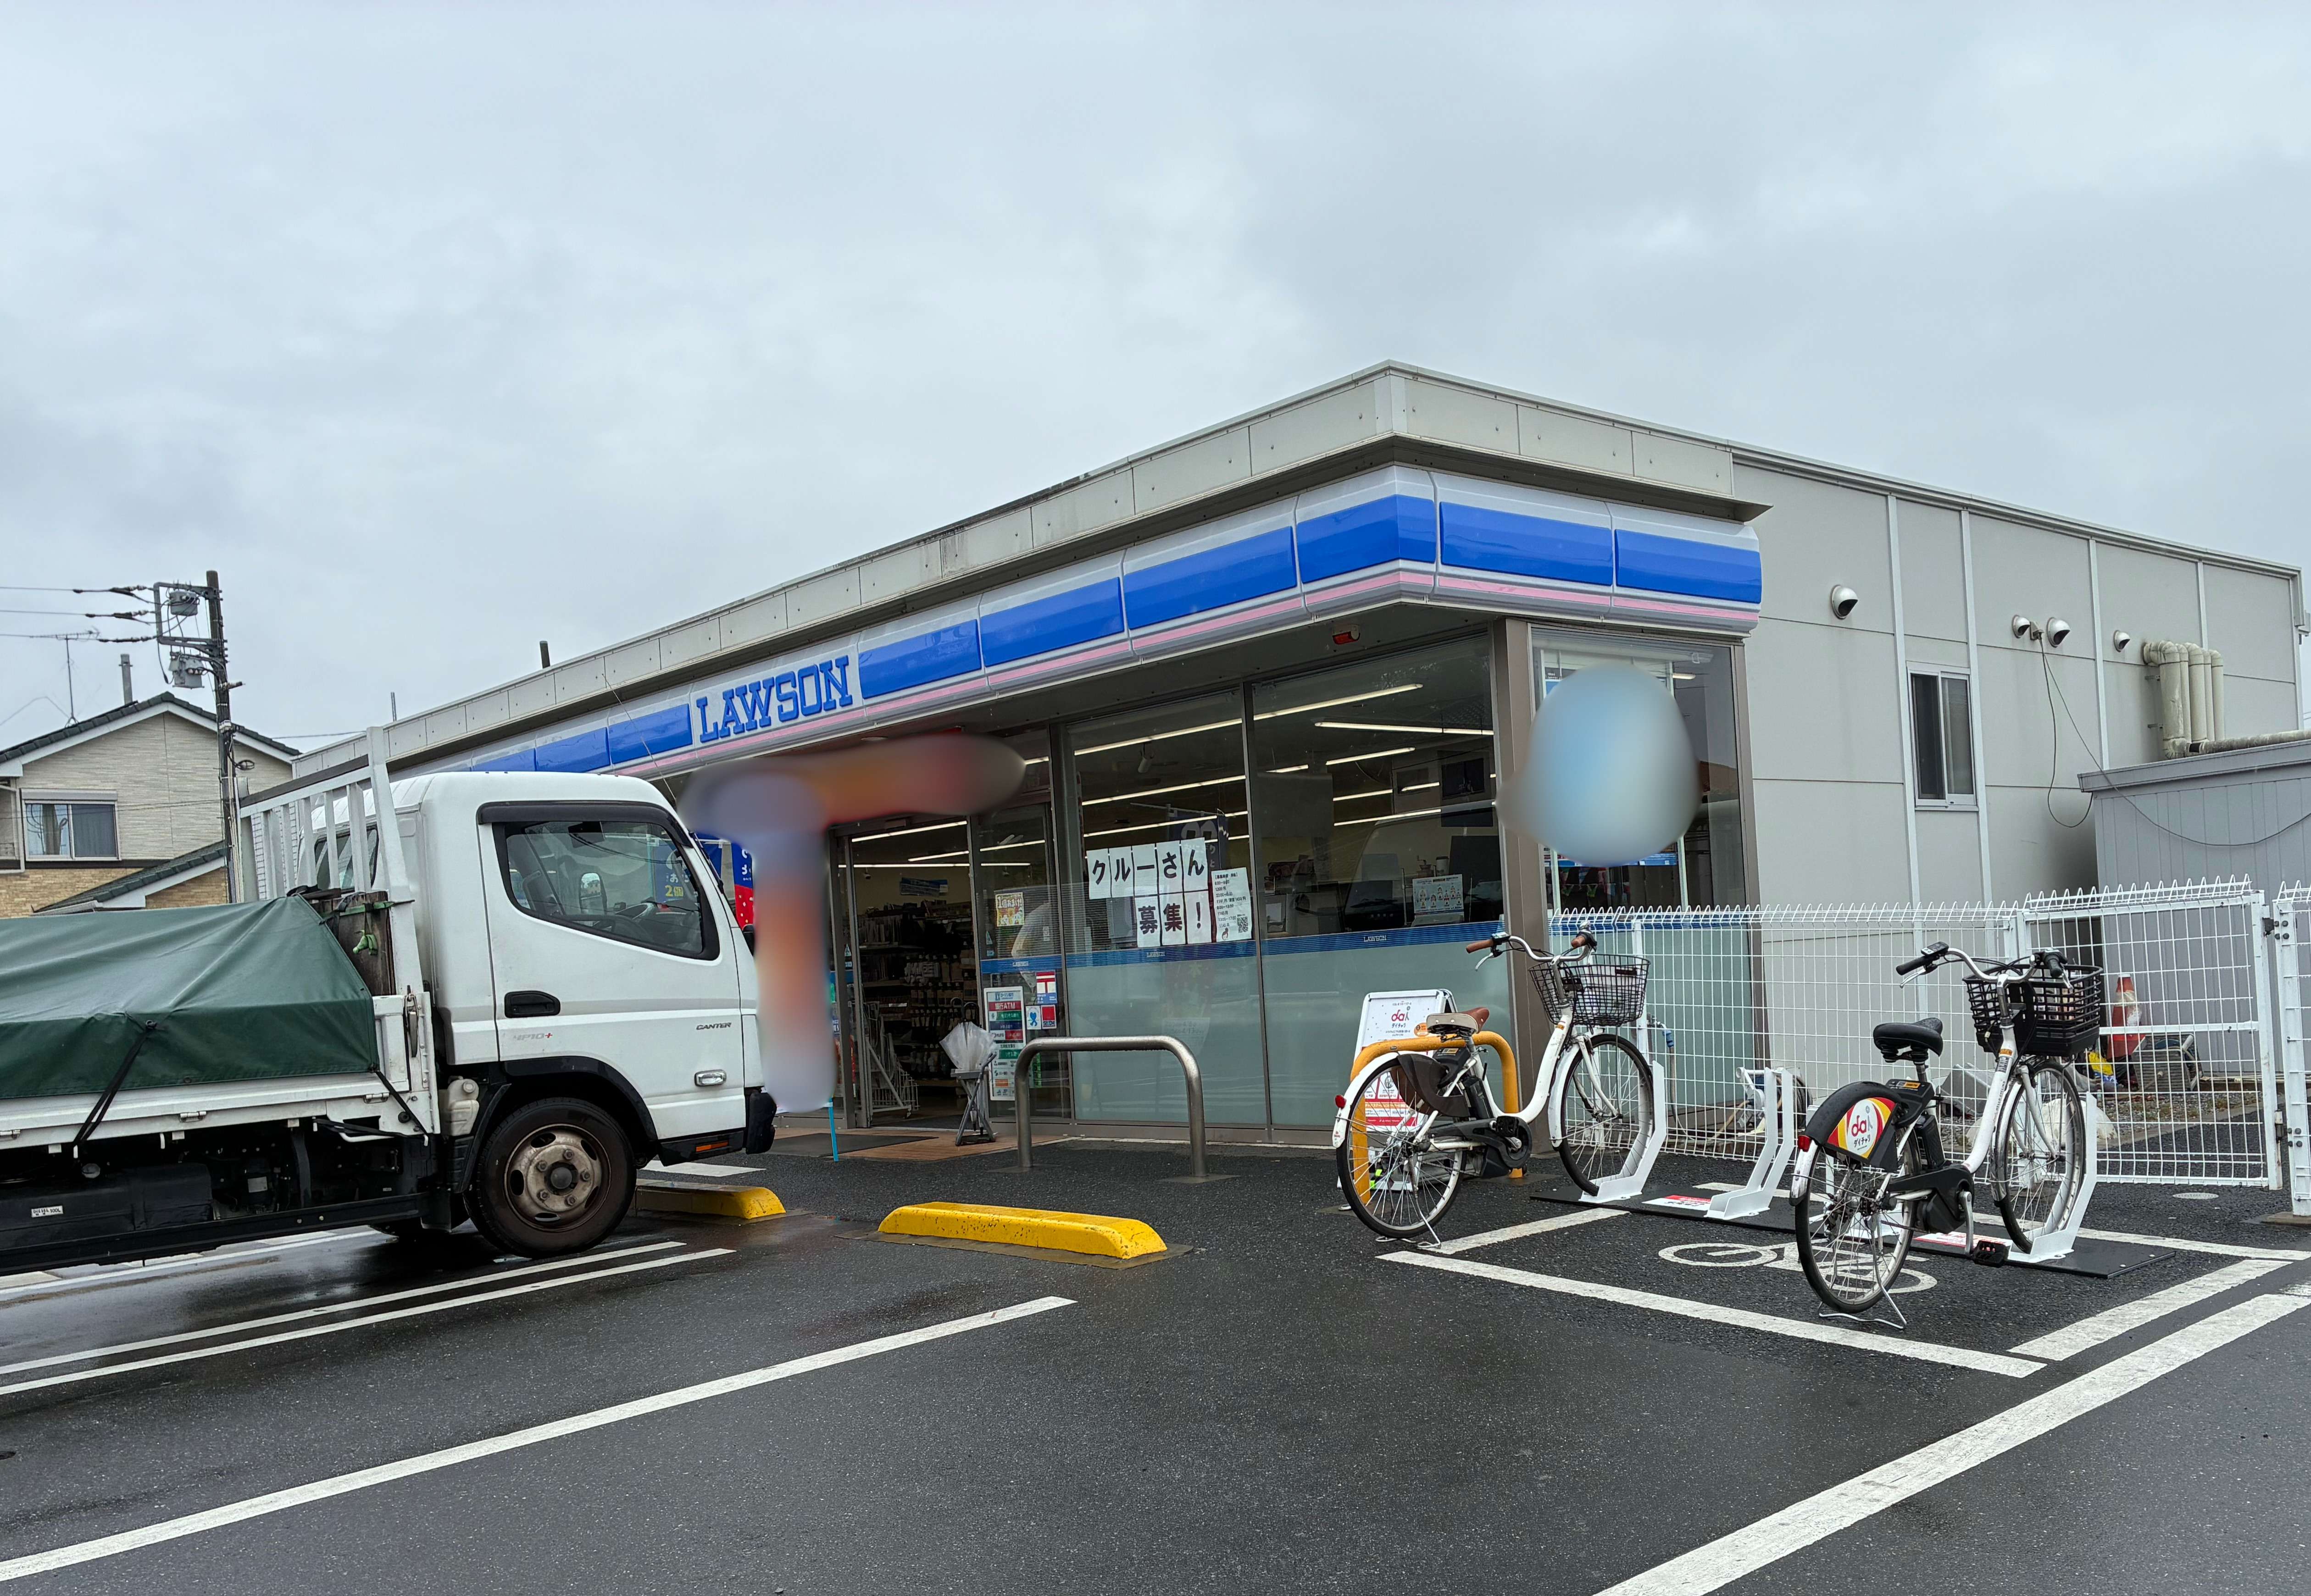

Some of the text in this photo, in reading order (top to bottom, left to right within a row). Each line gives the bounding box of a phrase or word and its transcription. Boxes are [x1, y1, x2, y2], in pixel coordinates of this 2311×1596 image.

[696, 655, 853, 743] LAWSON
[1092, 849, 1205, 885] クルーさん
[1854, 1134, 1871, 1148] ダイチャリ
